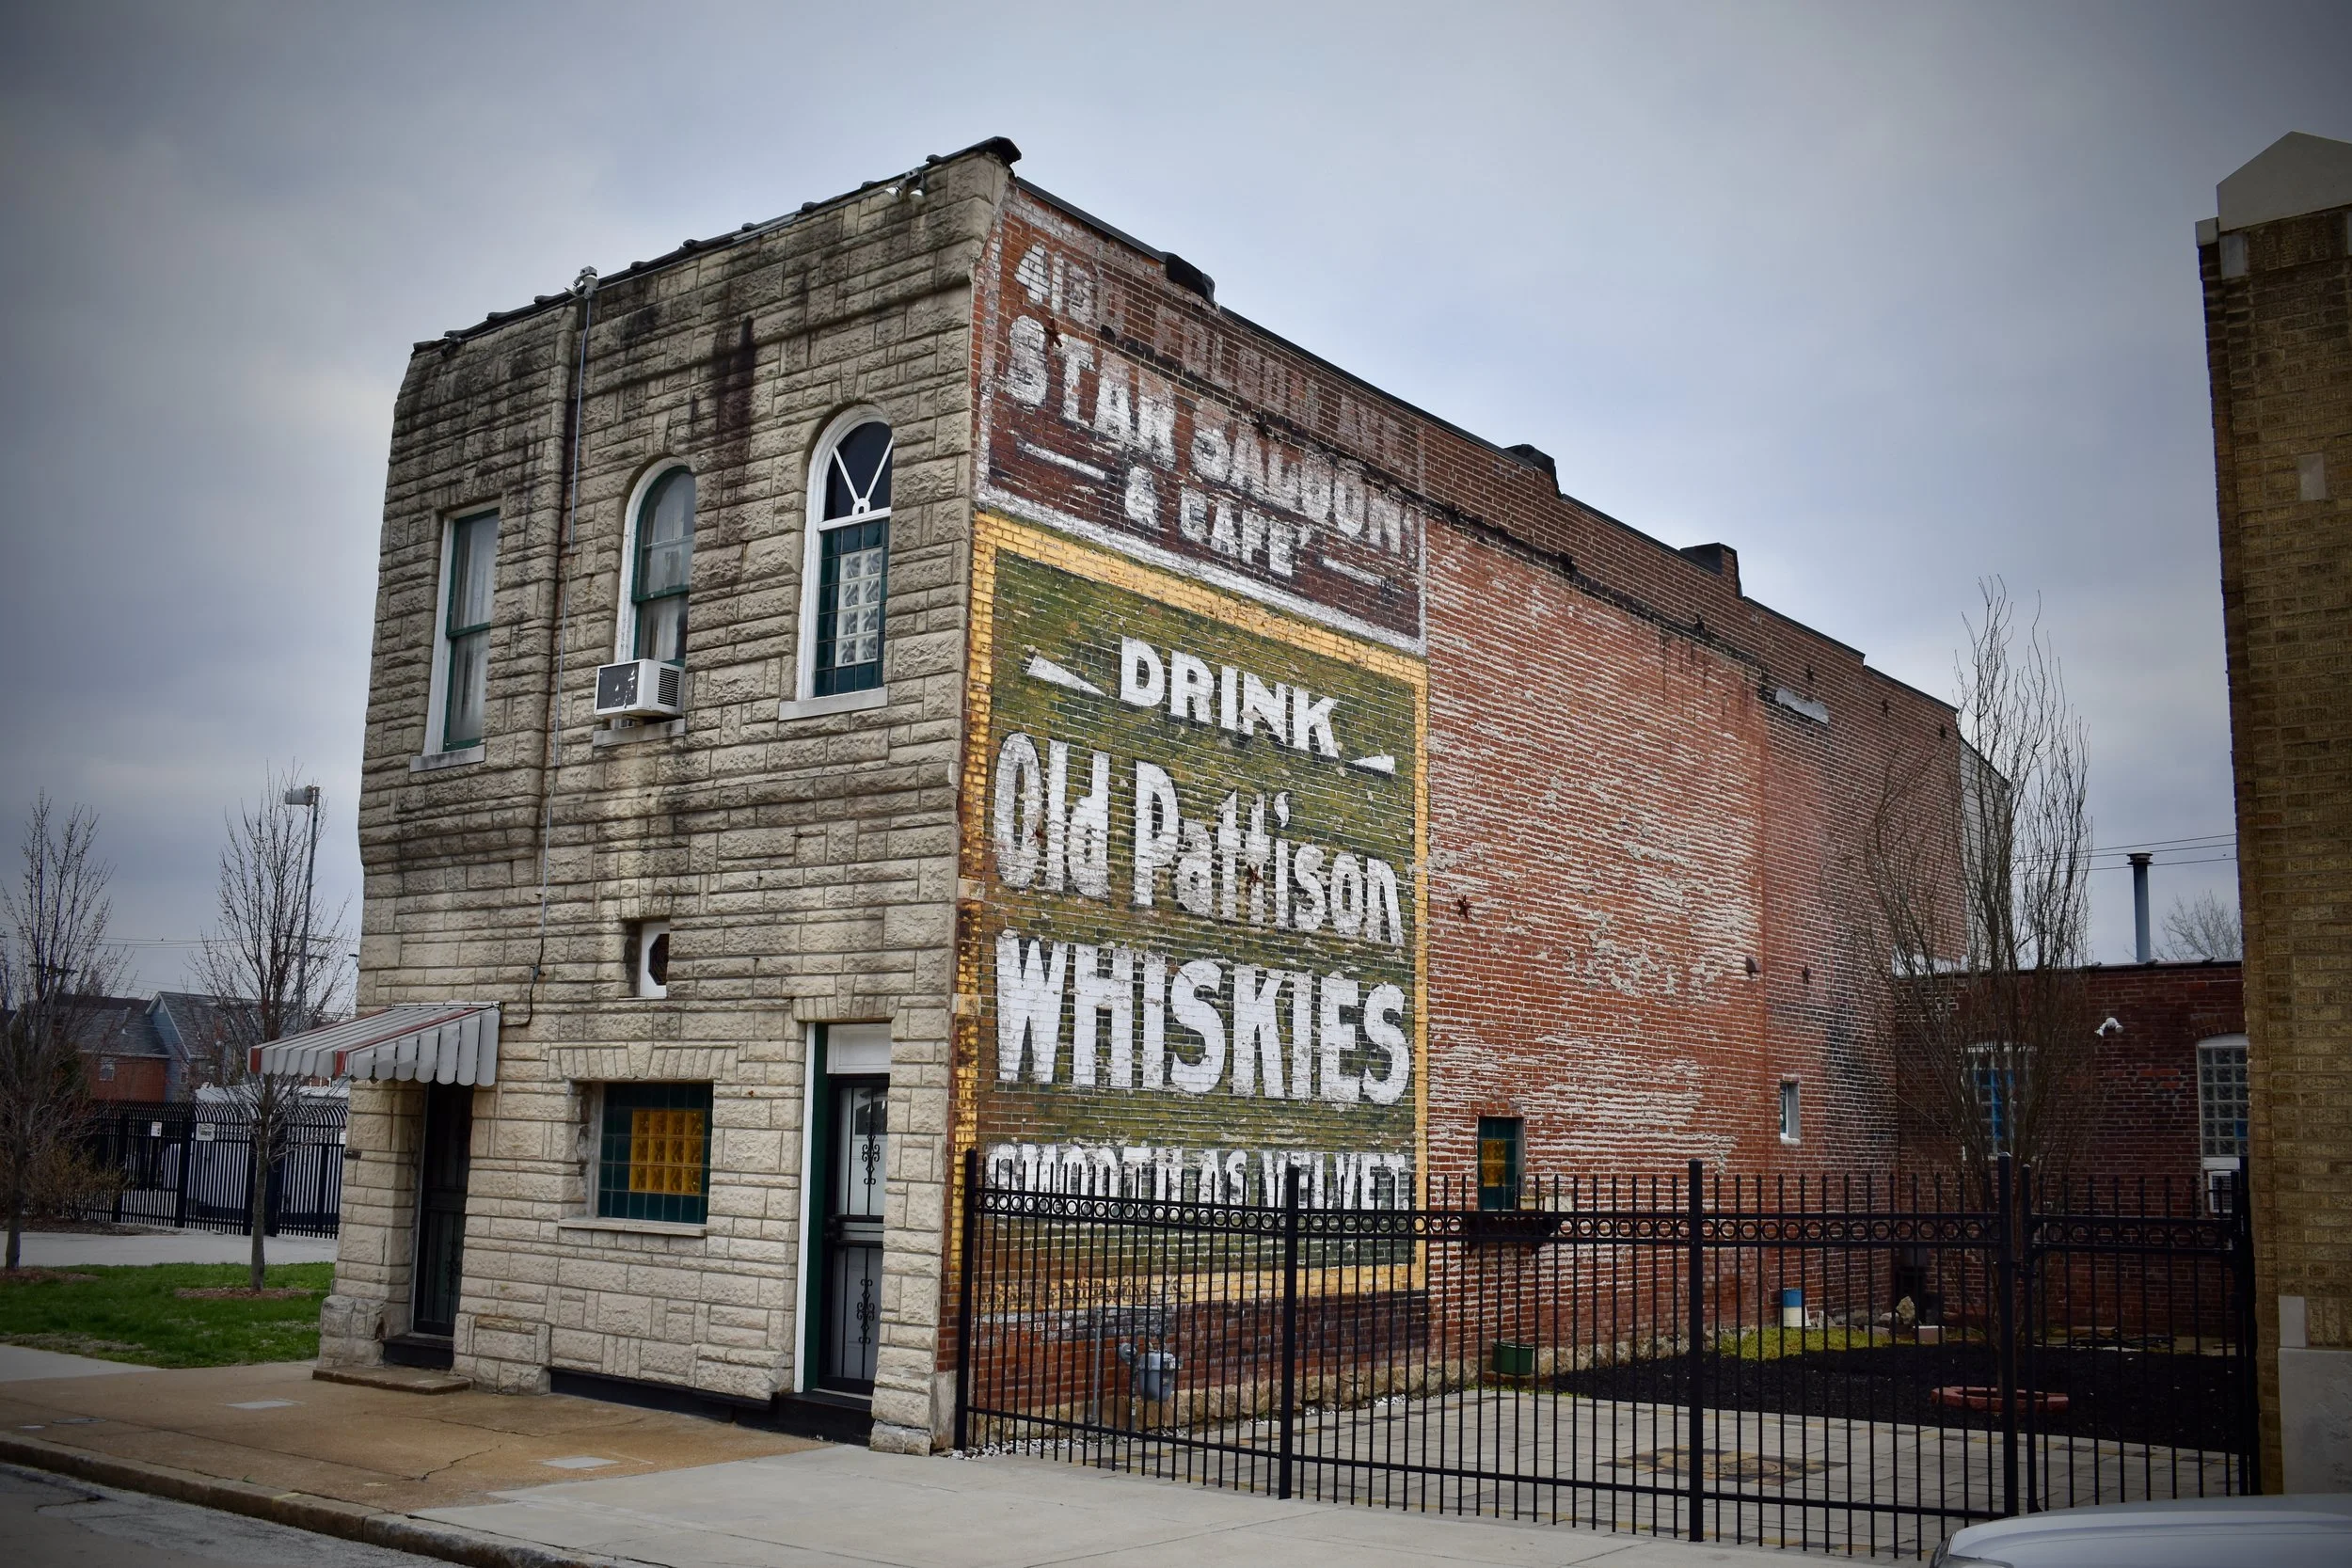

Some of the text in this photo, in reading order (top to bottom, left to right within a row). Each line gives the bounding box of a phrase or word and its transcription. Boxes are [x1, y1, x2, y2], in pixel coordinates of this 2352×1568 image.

[1006, 315, 1176, 469] STAR
[1125, 467, 1160, 530] &
[1119, 636, 1339, 759] DRINK
[995, 935, 1410, 1105] WHISKIES
[1199, 1148, 1249, 1213] AS
